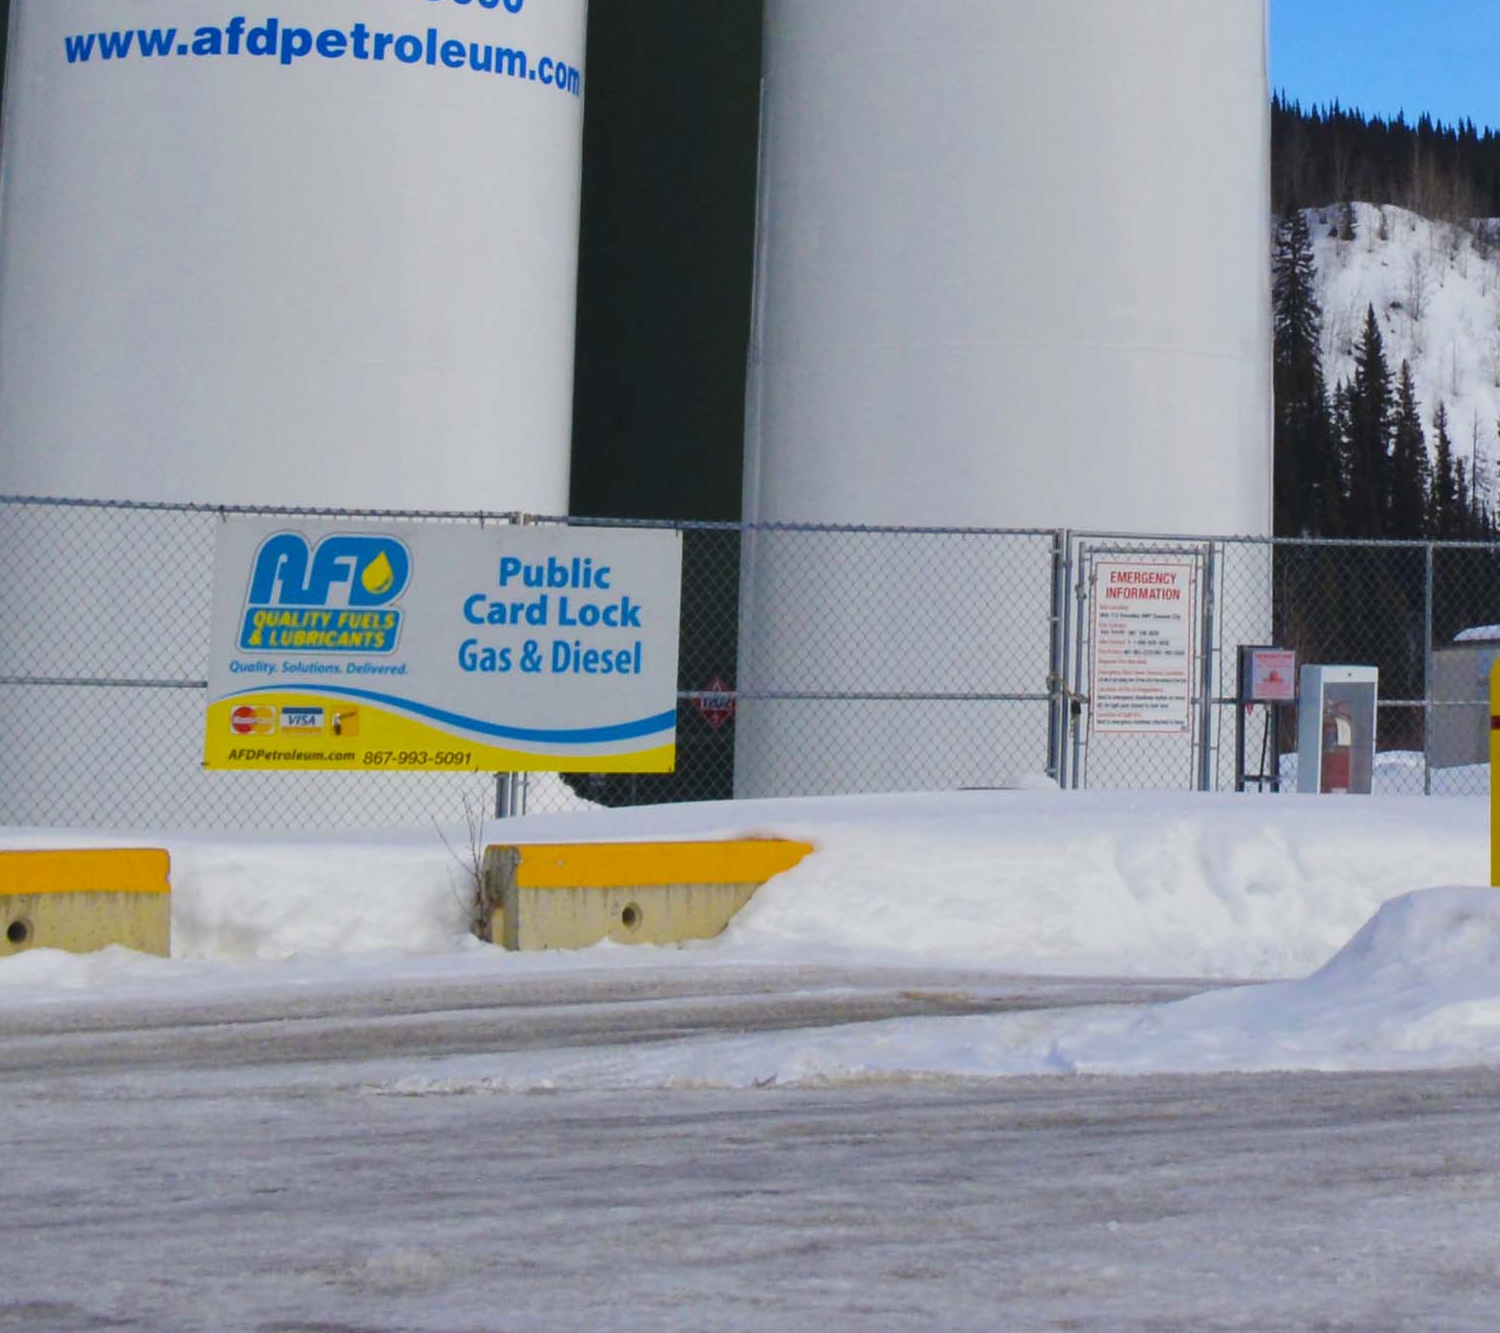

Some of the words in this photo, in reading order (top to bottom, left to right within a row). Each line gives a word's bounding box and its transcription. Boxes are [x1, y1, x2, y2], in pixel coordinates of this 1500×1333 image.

[64, 16, 581, 98] www.afdpetroleum.com
[249, 533, 409, 606] AFD
[498, 556, 611, 589] Public
[1109, 571, 1177, 585] EMERGENCY
[1105, 586, 1180, 600] INFORMATION
[463, 593, 549, 626] Card
[558, 596, 642, 627] Lock
[253, 610, 333, 631] QUALITY
[337, 612, 396, 629] FUELS
[248, 630, 262, 646] &
[269, 630, 385, 649] LUBRICANTS
[457, 638, 512, 673] Gas
[519, 639, 543, 673] &
[551, 639, 642, 674] Diesel
[229, 660, 278, 675] Quality.
[282, 661, 342, 674] Solutions.
[346, 662, 409, 676] Delivered.
[287, 715, 317, 727] VISA
[227, 748, 356, 762] AFDPetroleum.com
[362, 750, 473, 766] 867-993-5091
